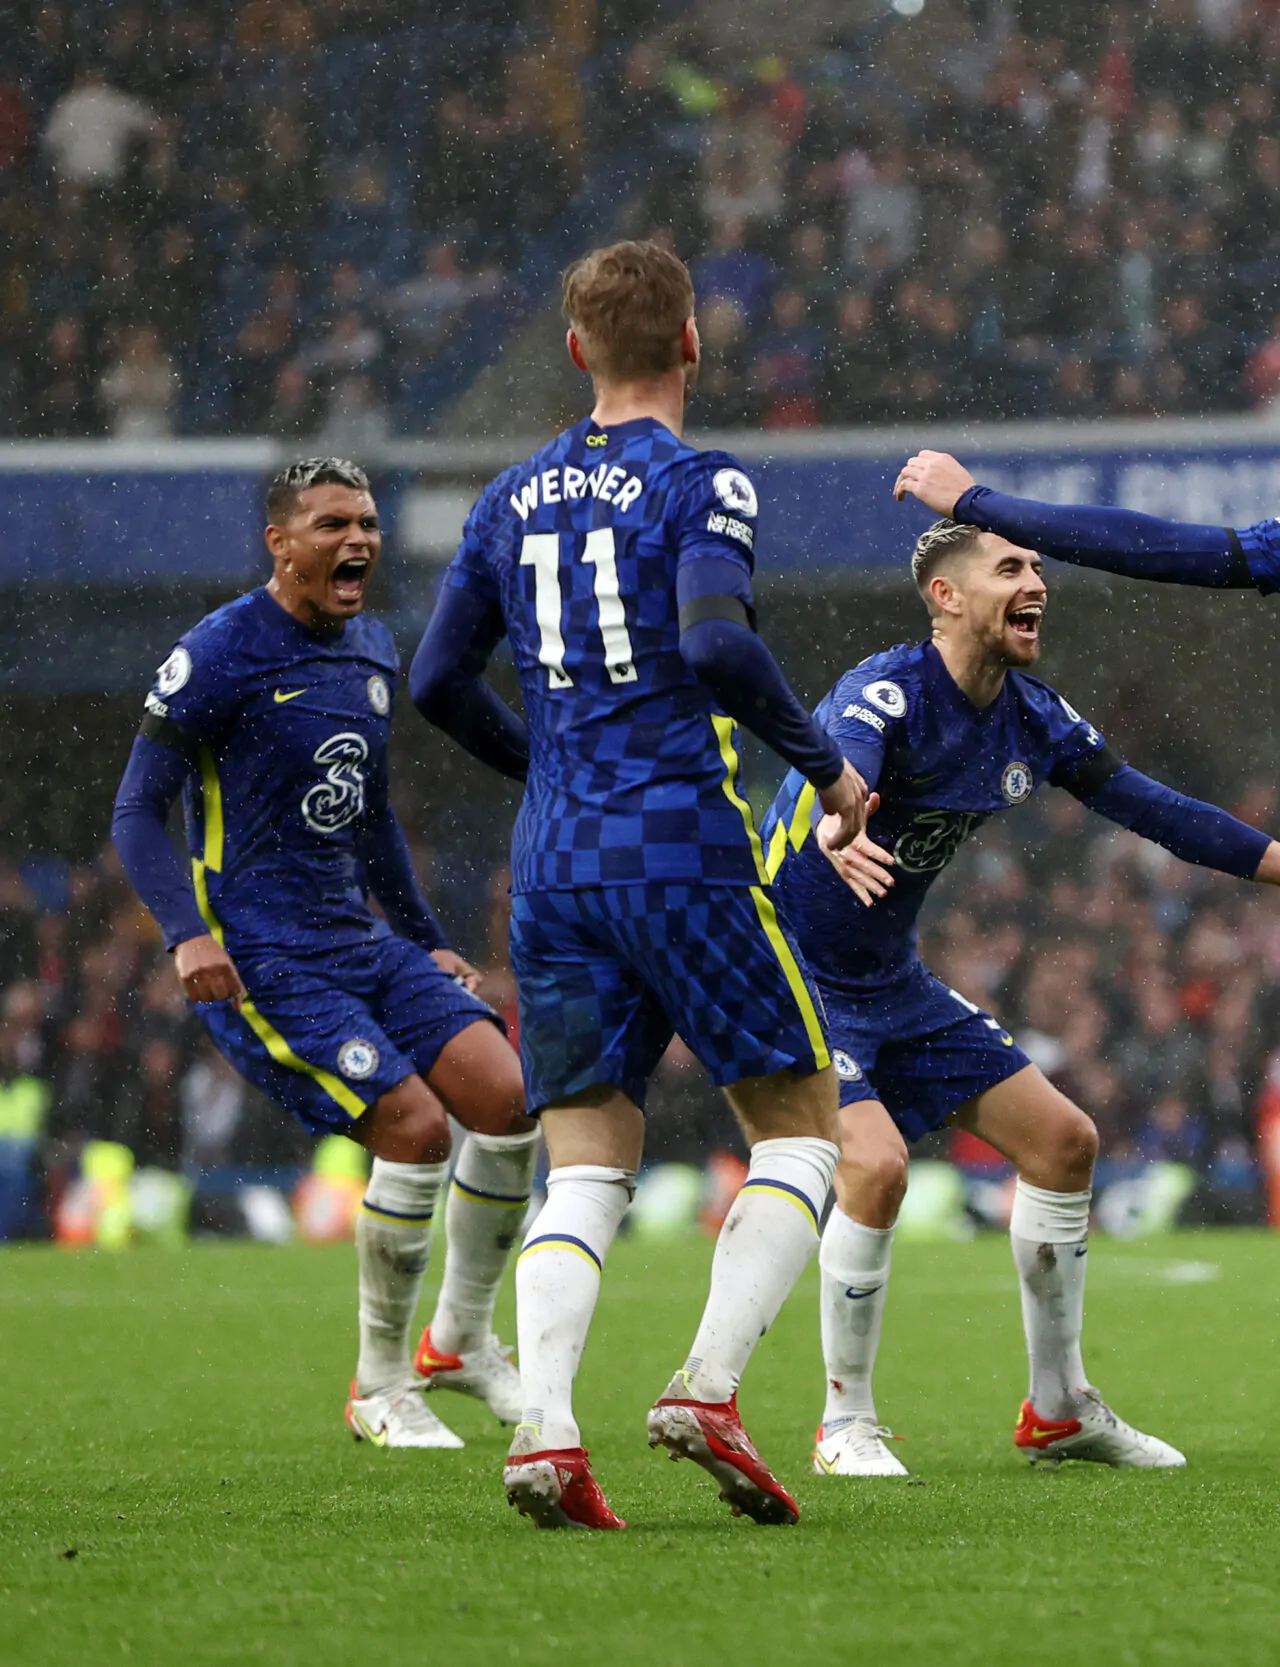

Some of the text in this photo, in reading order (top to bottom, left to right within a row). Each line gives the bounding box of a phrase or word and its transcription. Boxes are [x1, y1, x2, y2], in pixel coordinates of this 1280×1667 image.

[586, 434, 608, 447] CFC
[510, 463, 643, 521] WERNER
[519, 527, 638, 690] 11
[301, 732, 369, 832] 3
